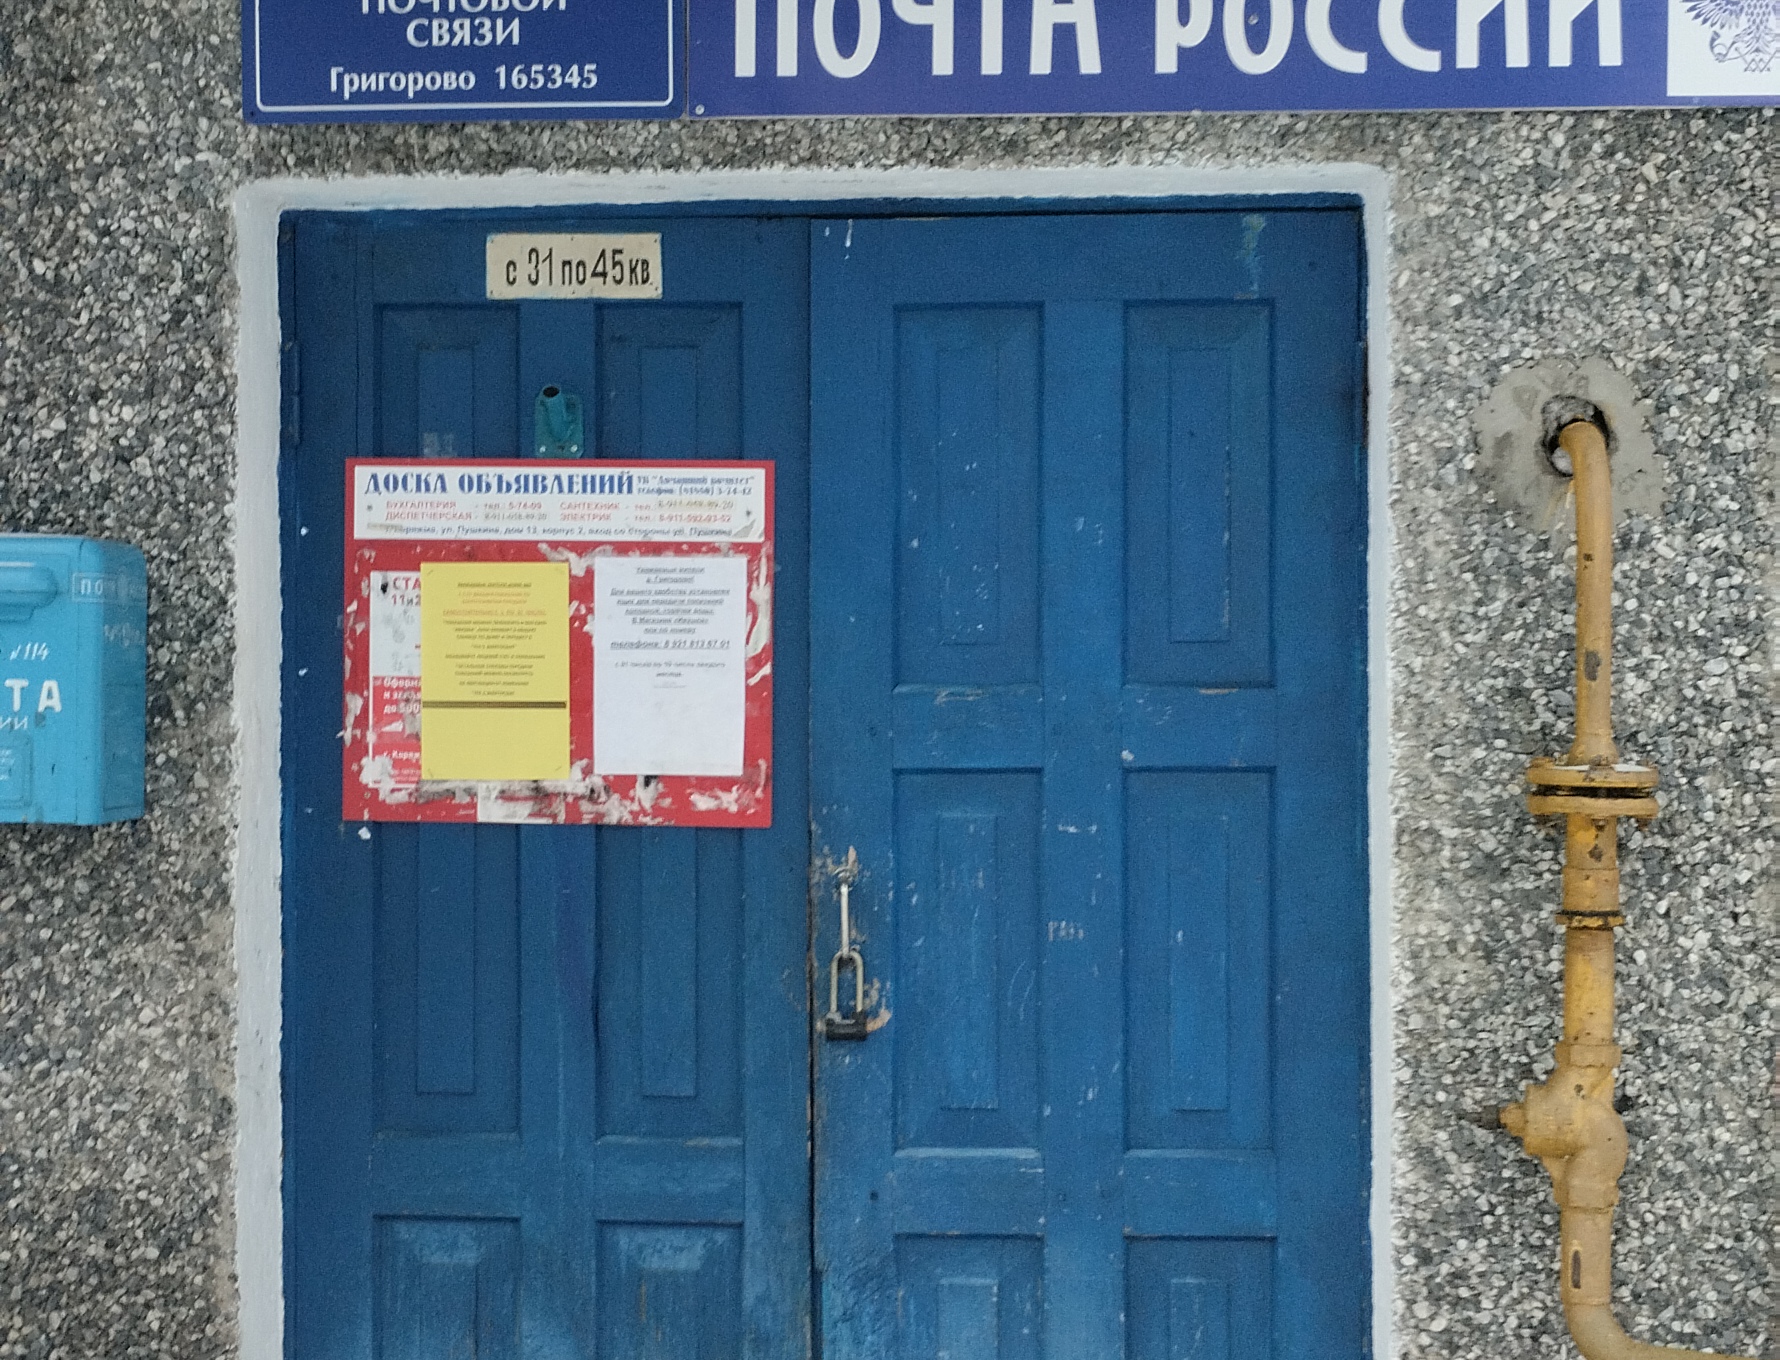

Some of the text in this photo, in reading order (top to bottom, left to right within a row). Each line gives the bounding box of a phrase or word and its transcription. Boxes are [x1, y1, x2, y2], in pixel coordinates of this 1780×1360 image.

[406, 17, 520, 48] СВЯЗИ
[330, 63, 598, 100] Григорово 165345
[505, 260, 517, 286] с
[528, 247, 553, 286] 31
[562, 259, 587, 286] по
[591, 248, 625, 286] 45
[364, 472, 448, 495] ДОСКА
[458, 470, 633, 495] ОБЪЯВЛЕНИЙ
[386, 501, 456, 509] БУХГАЛТЕРИЯ
